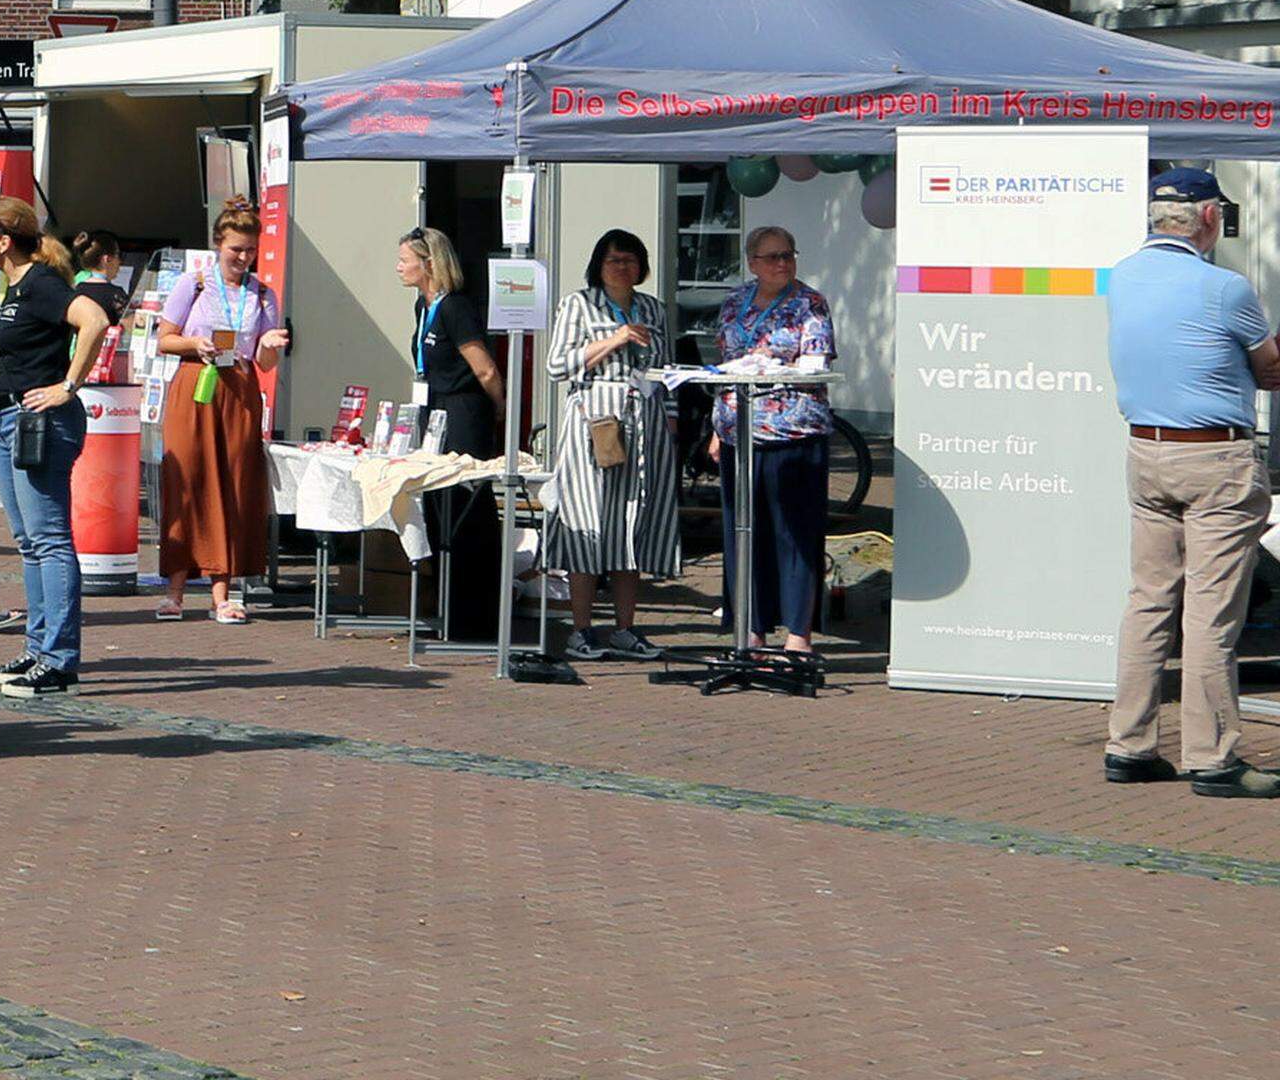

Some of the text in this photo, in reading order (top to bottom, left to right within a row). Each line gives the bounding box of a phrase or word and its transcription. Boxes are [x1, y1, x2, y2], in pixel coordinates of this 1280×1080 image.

[551, 87, 1274, 128] Die Selbsthilfegruppen im Kreis Heinsberg
[956, 174, 1124, 193] DER PARITÄTISCHE
[956, 195, 983, 204] KREIS
[919, 322, 986, 351] Wir
[918, 362, 1104, 392] verändern.
[919, 432, 1038, 455] Partner für
[916, 471, 1074, 493] soziale Arbeit.
